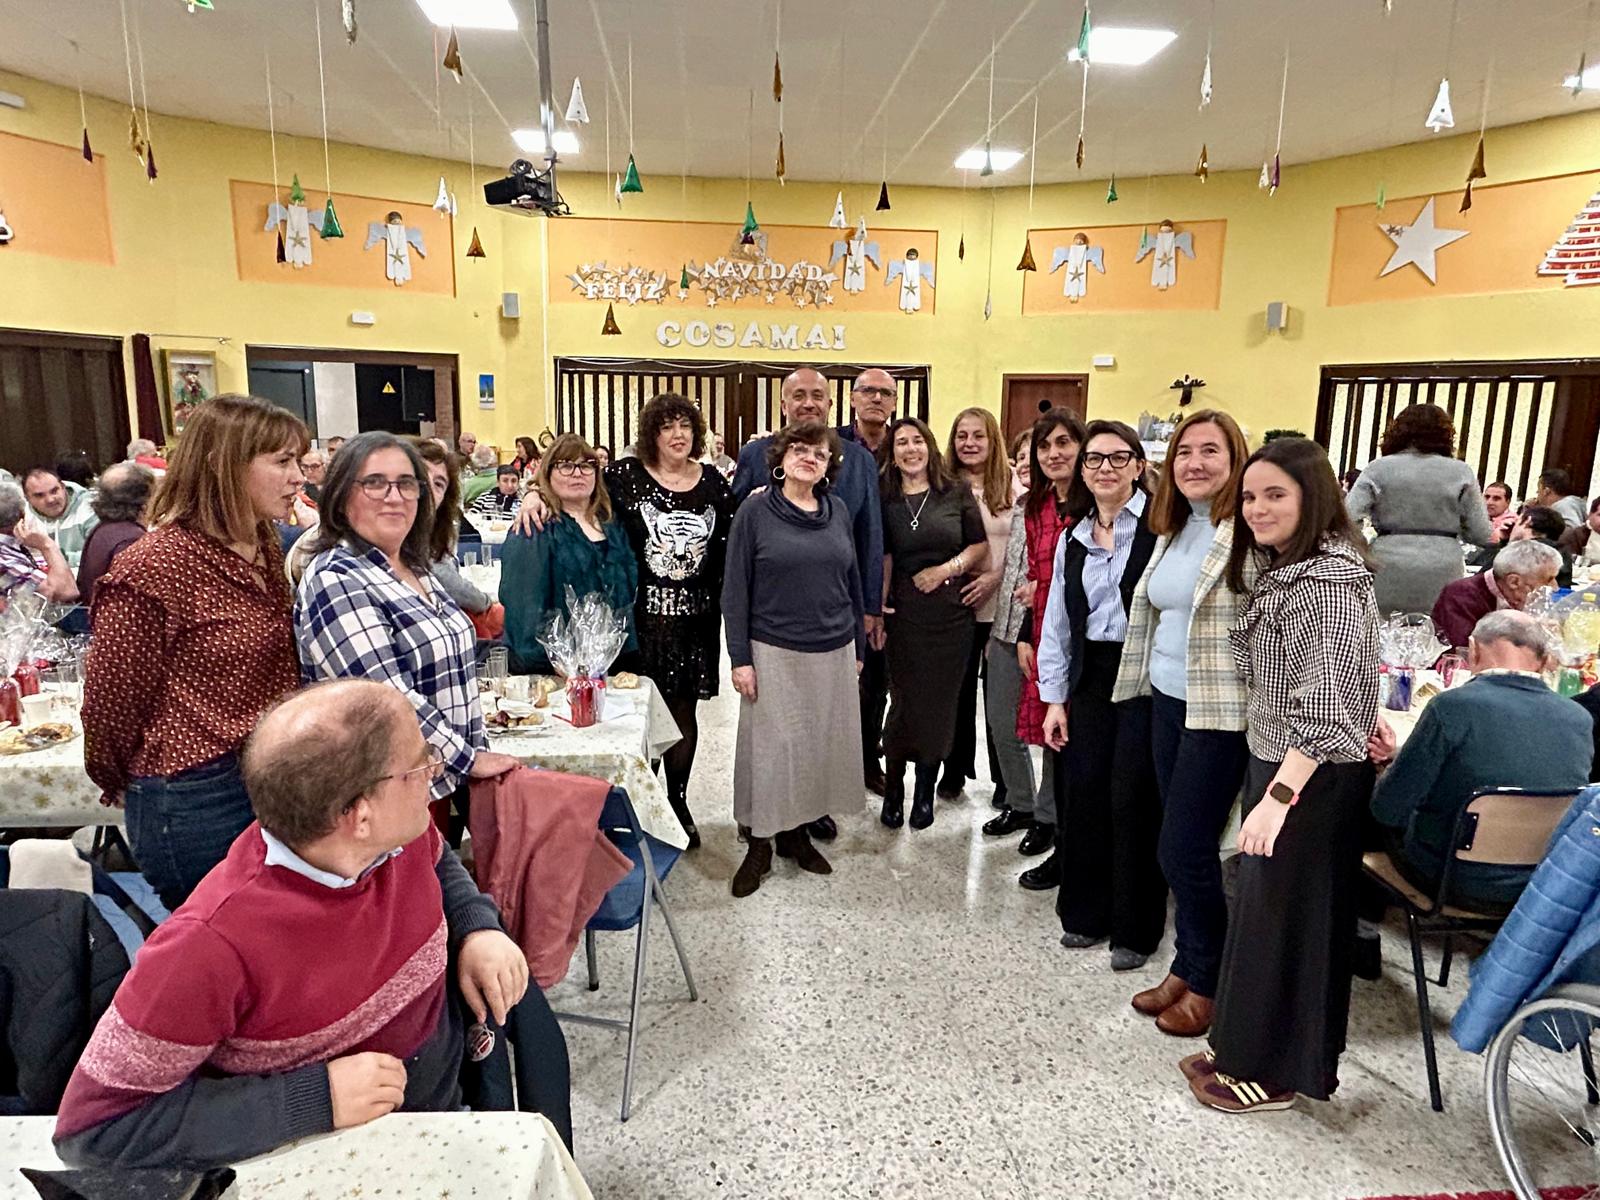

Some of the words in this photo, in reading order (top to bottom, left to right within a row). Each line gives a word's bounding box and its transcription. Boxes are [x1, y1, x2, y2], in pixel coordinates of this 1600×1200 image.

[585, 281, 661, 300] FELIZ
[703, 260, 824, 281] NAVIDAD
[655, 320, 847, 351] COSAMAI
